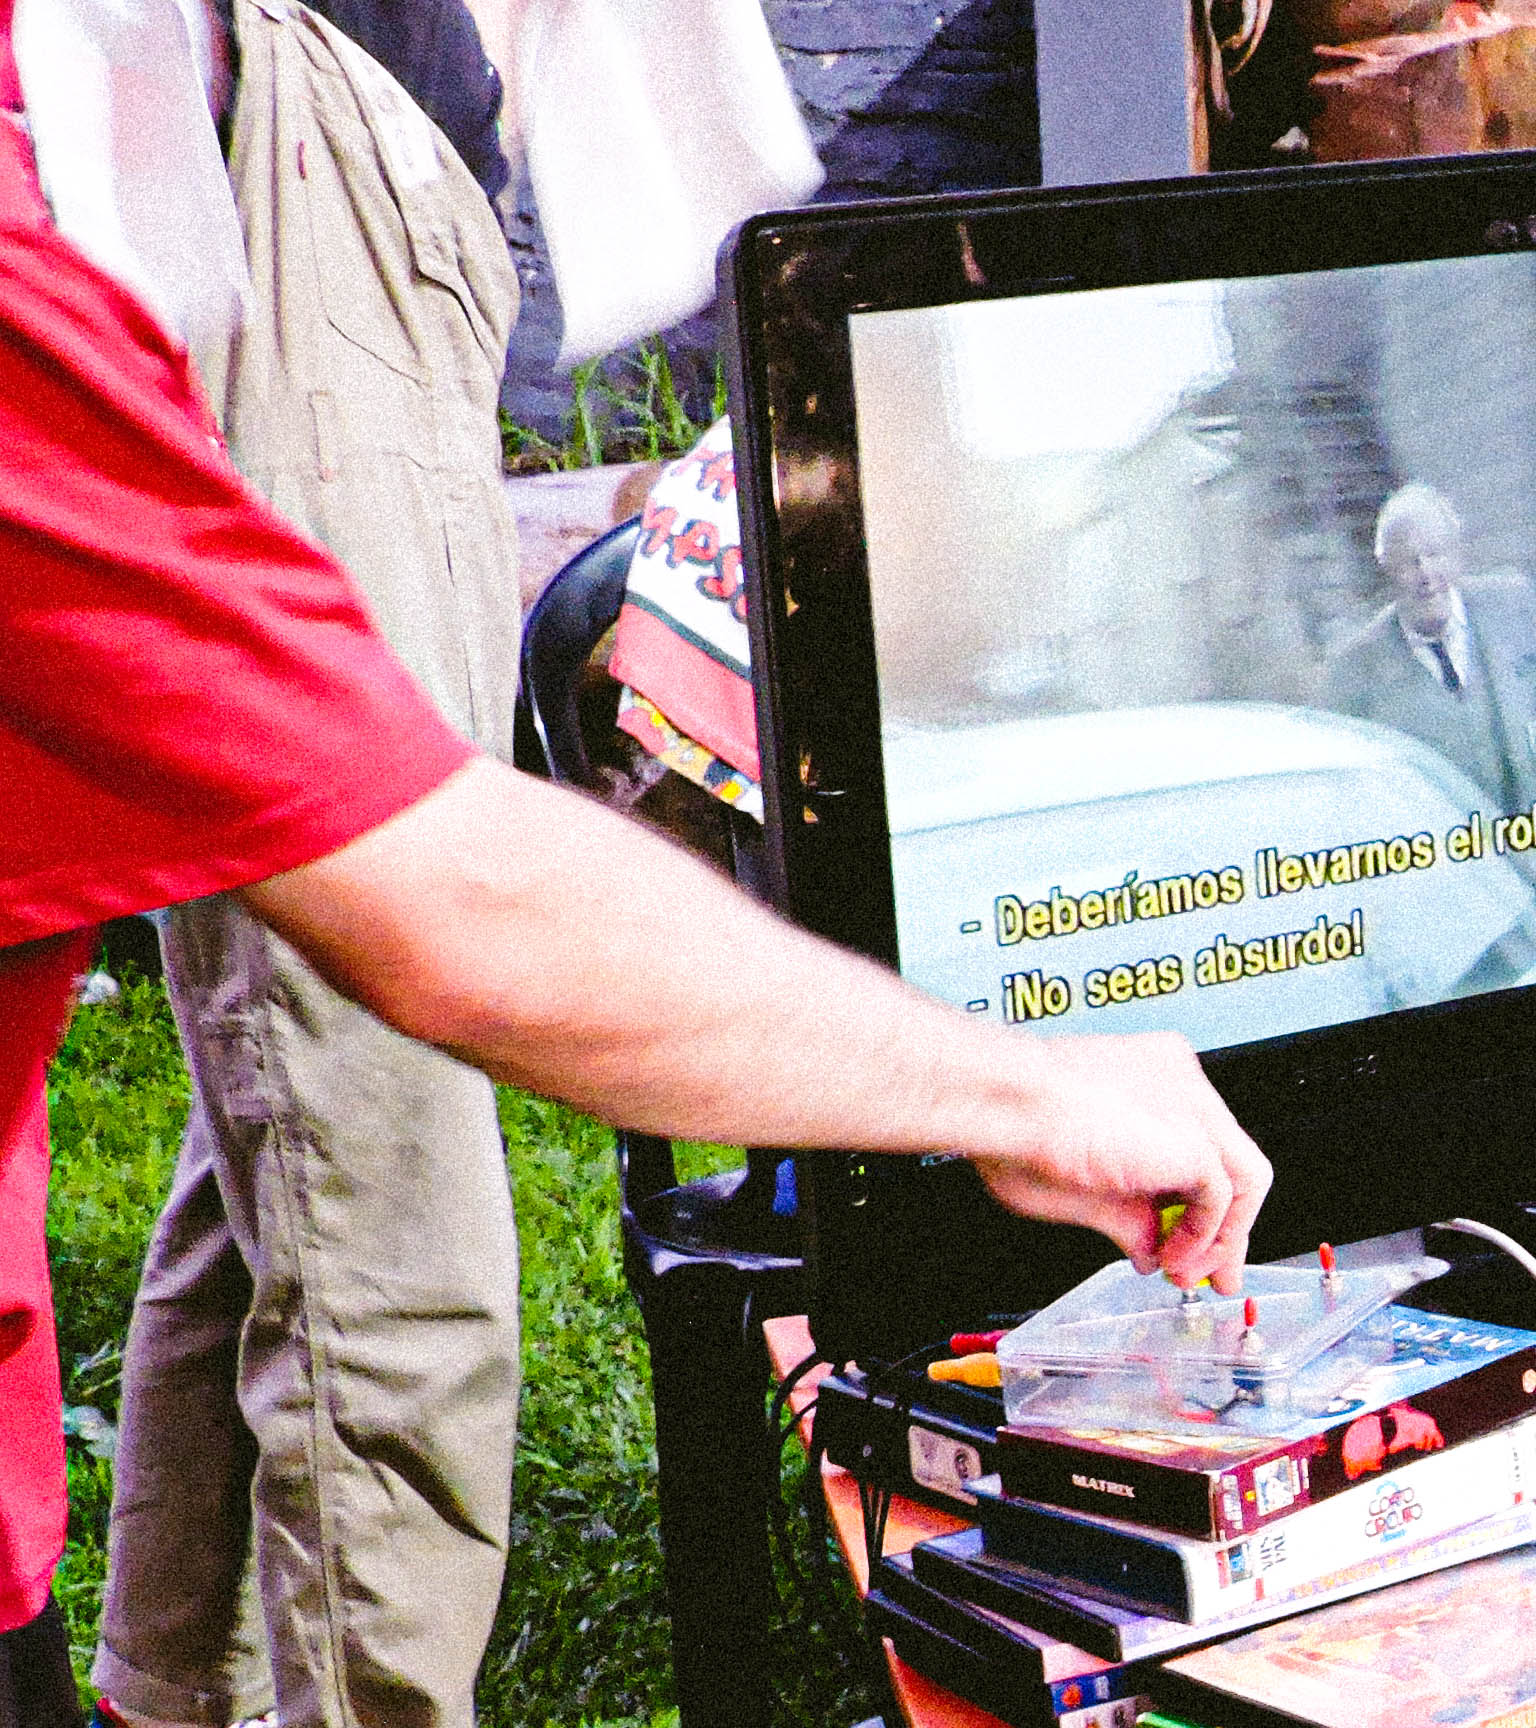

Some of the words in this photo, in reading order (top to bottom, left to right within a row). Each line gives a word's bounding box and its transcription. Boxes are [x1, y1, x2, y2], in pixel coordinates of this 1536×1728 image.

[994, 865, 1245, 947] Deberíamos
[1255, 830, 1436, 899] llevarnos
[1446, 811, 1484, 863] el
[1084, 954, 1185, 1009] seas
[1194, 908, 1364, 988] absurdo!
[1071, 1472, 1136, 1499] MATRIX
